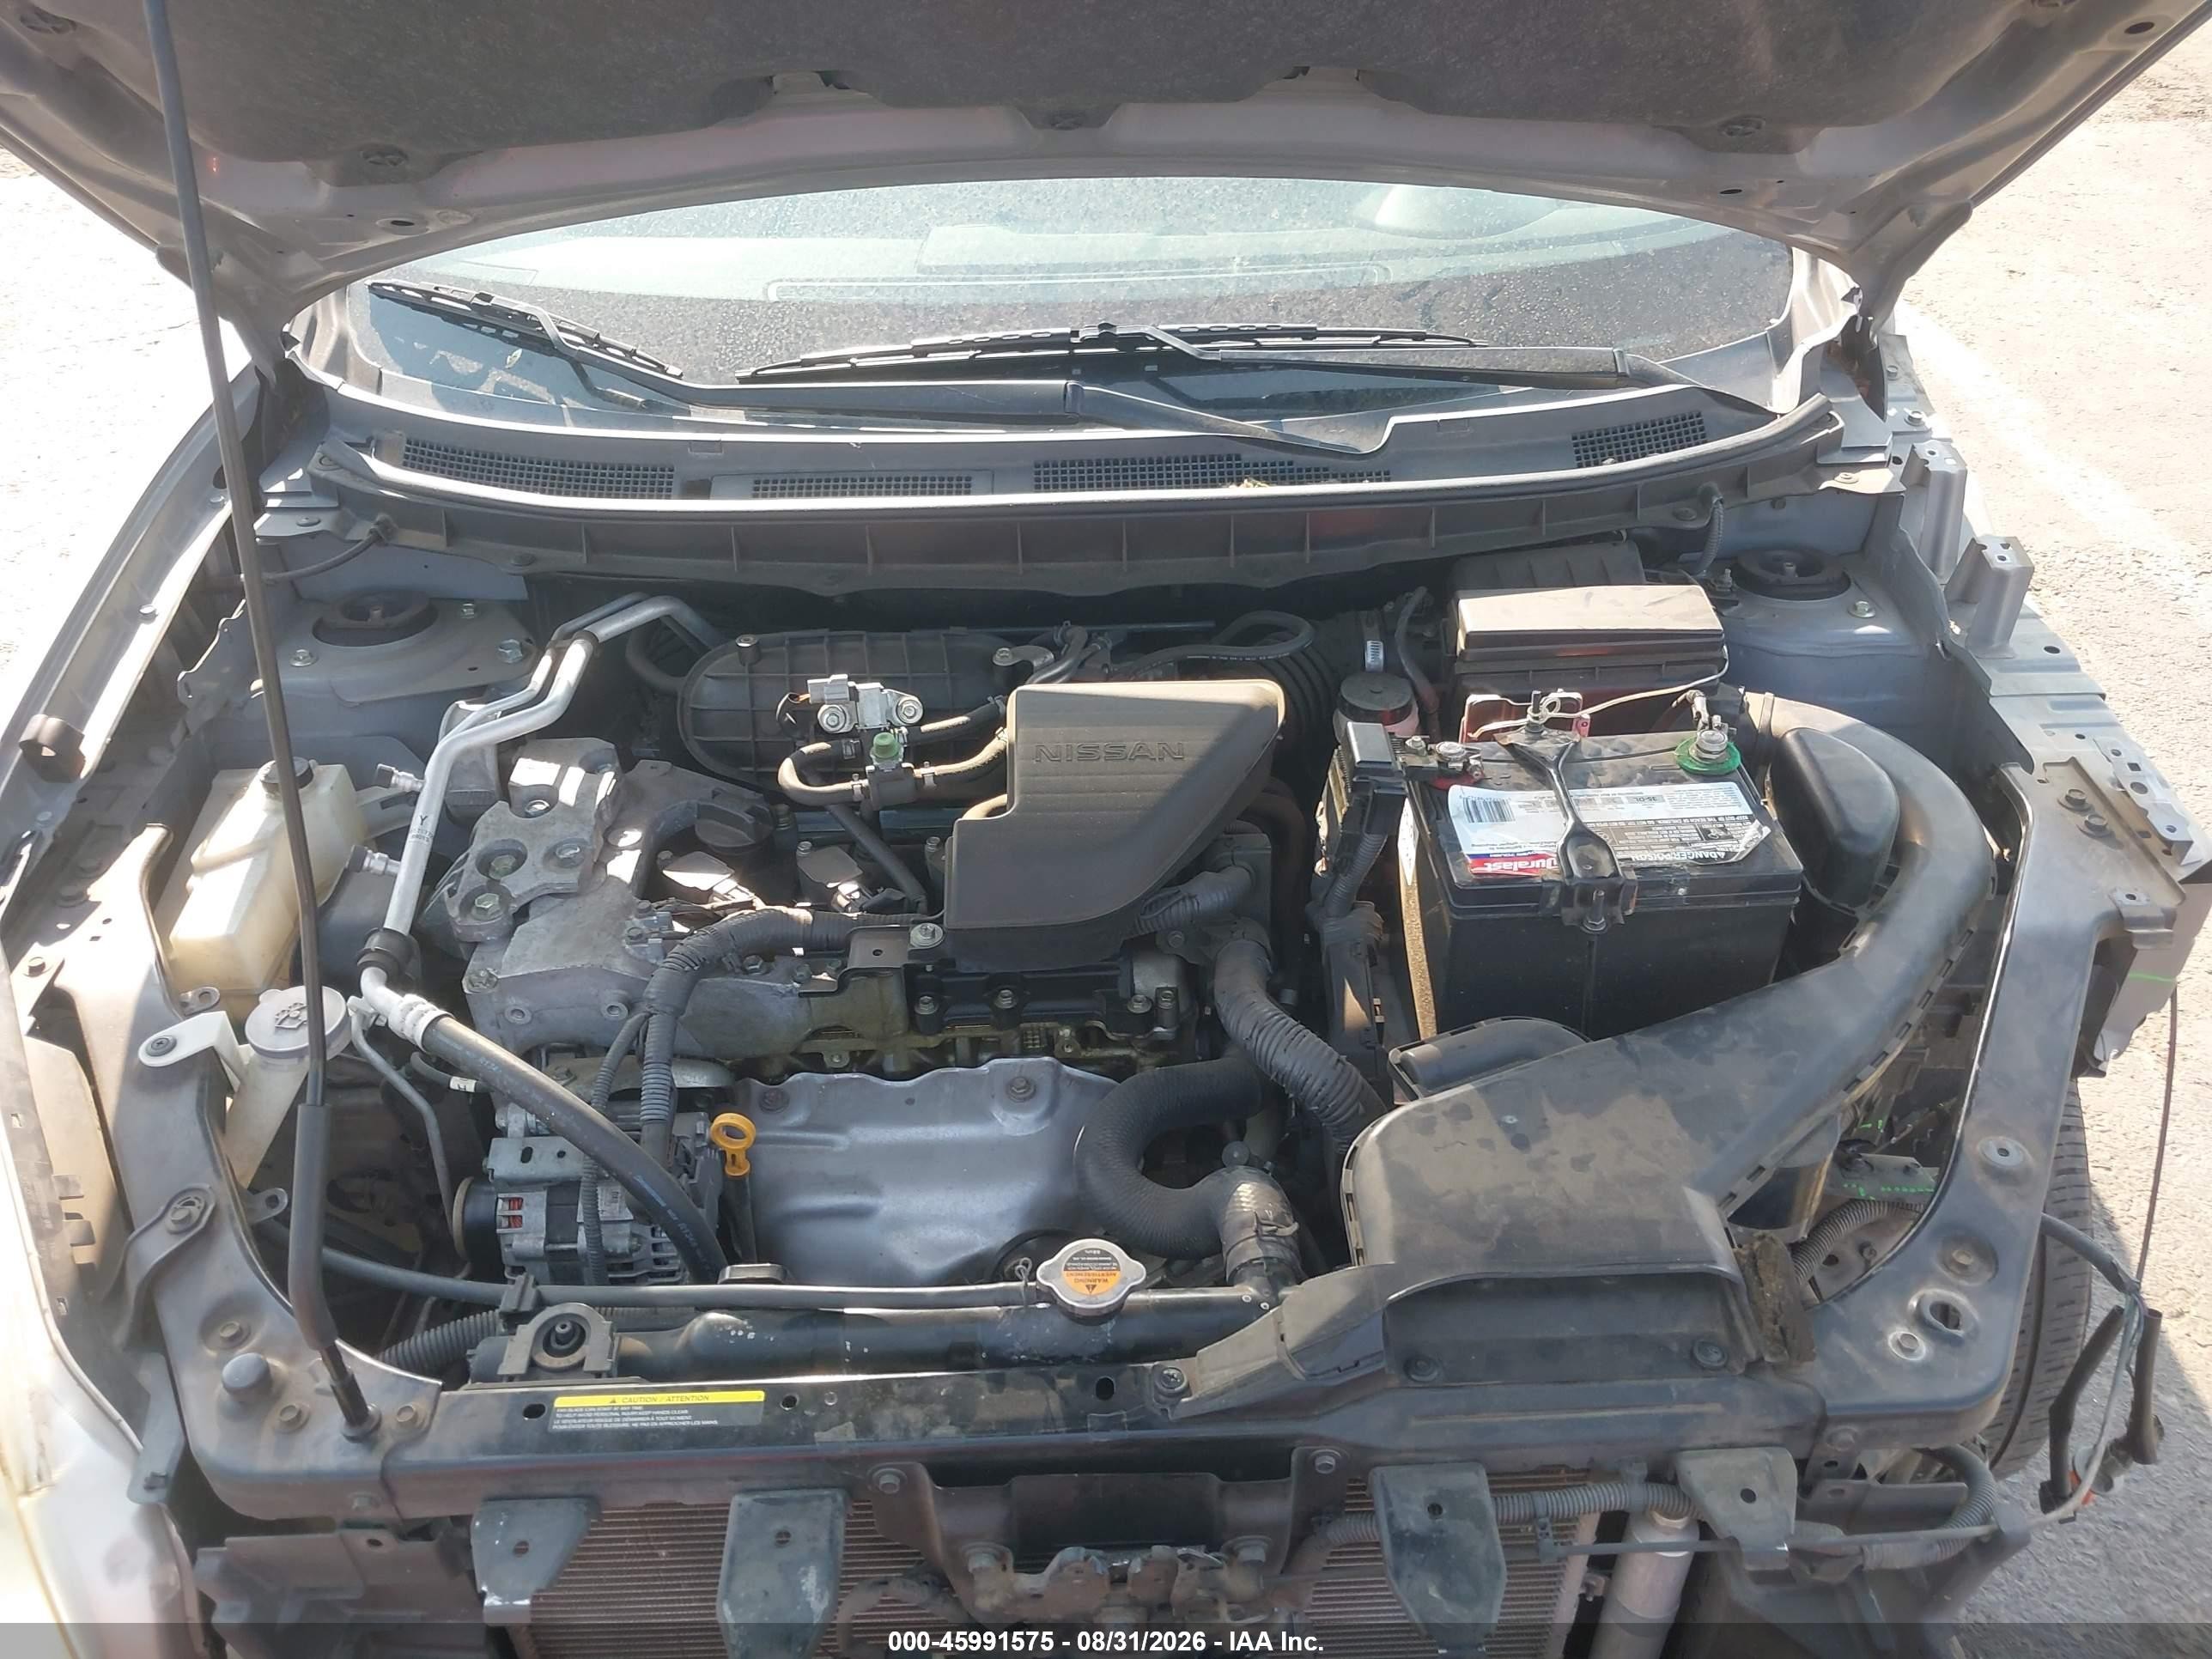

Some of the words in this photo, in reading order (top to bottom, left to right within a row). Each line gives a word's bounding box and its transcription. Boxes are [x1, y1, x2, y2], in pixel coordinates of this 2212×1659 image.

[1034, 741, 1185, 763] NISSAN
[1483, 857, 1558, 872] Duralast
[665, 1394, 710, 1402] ATTENTION
